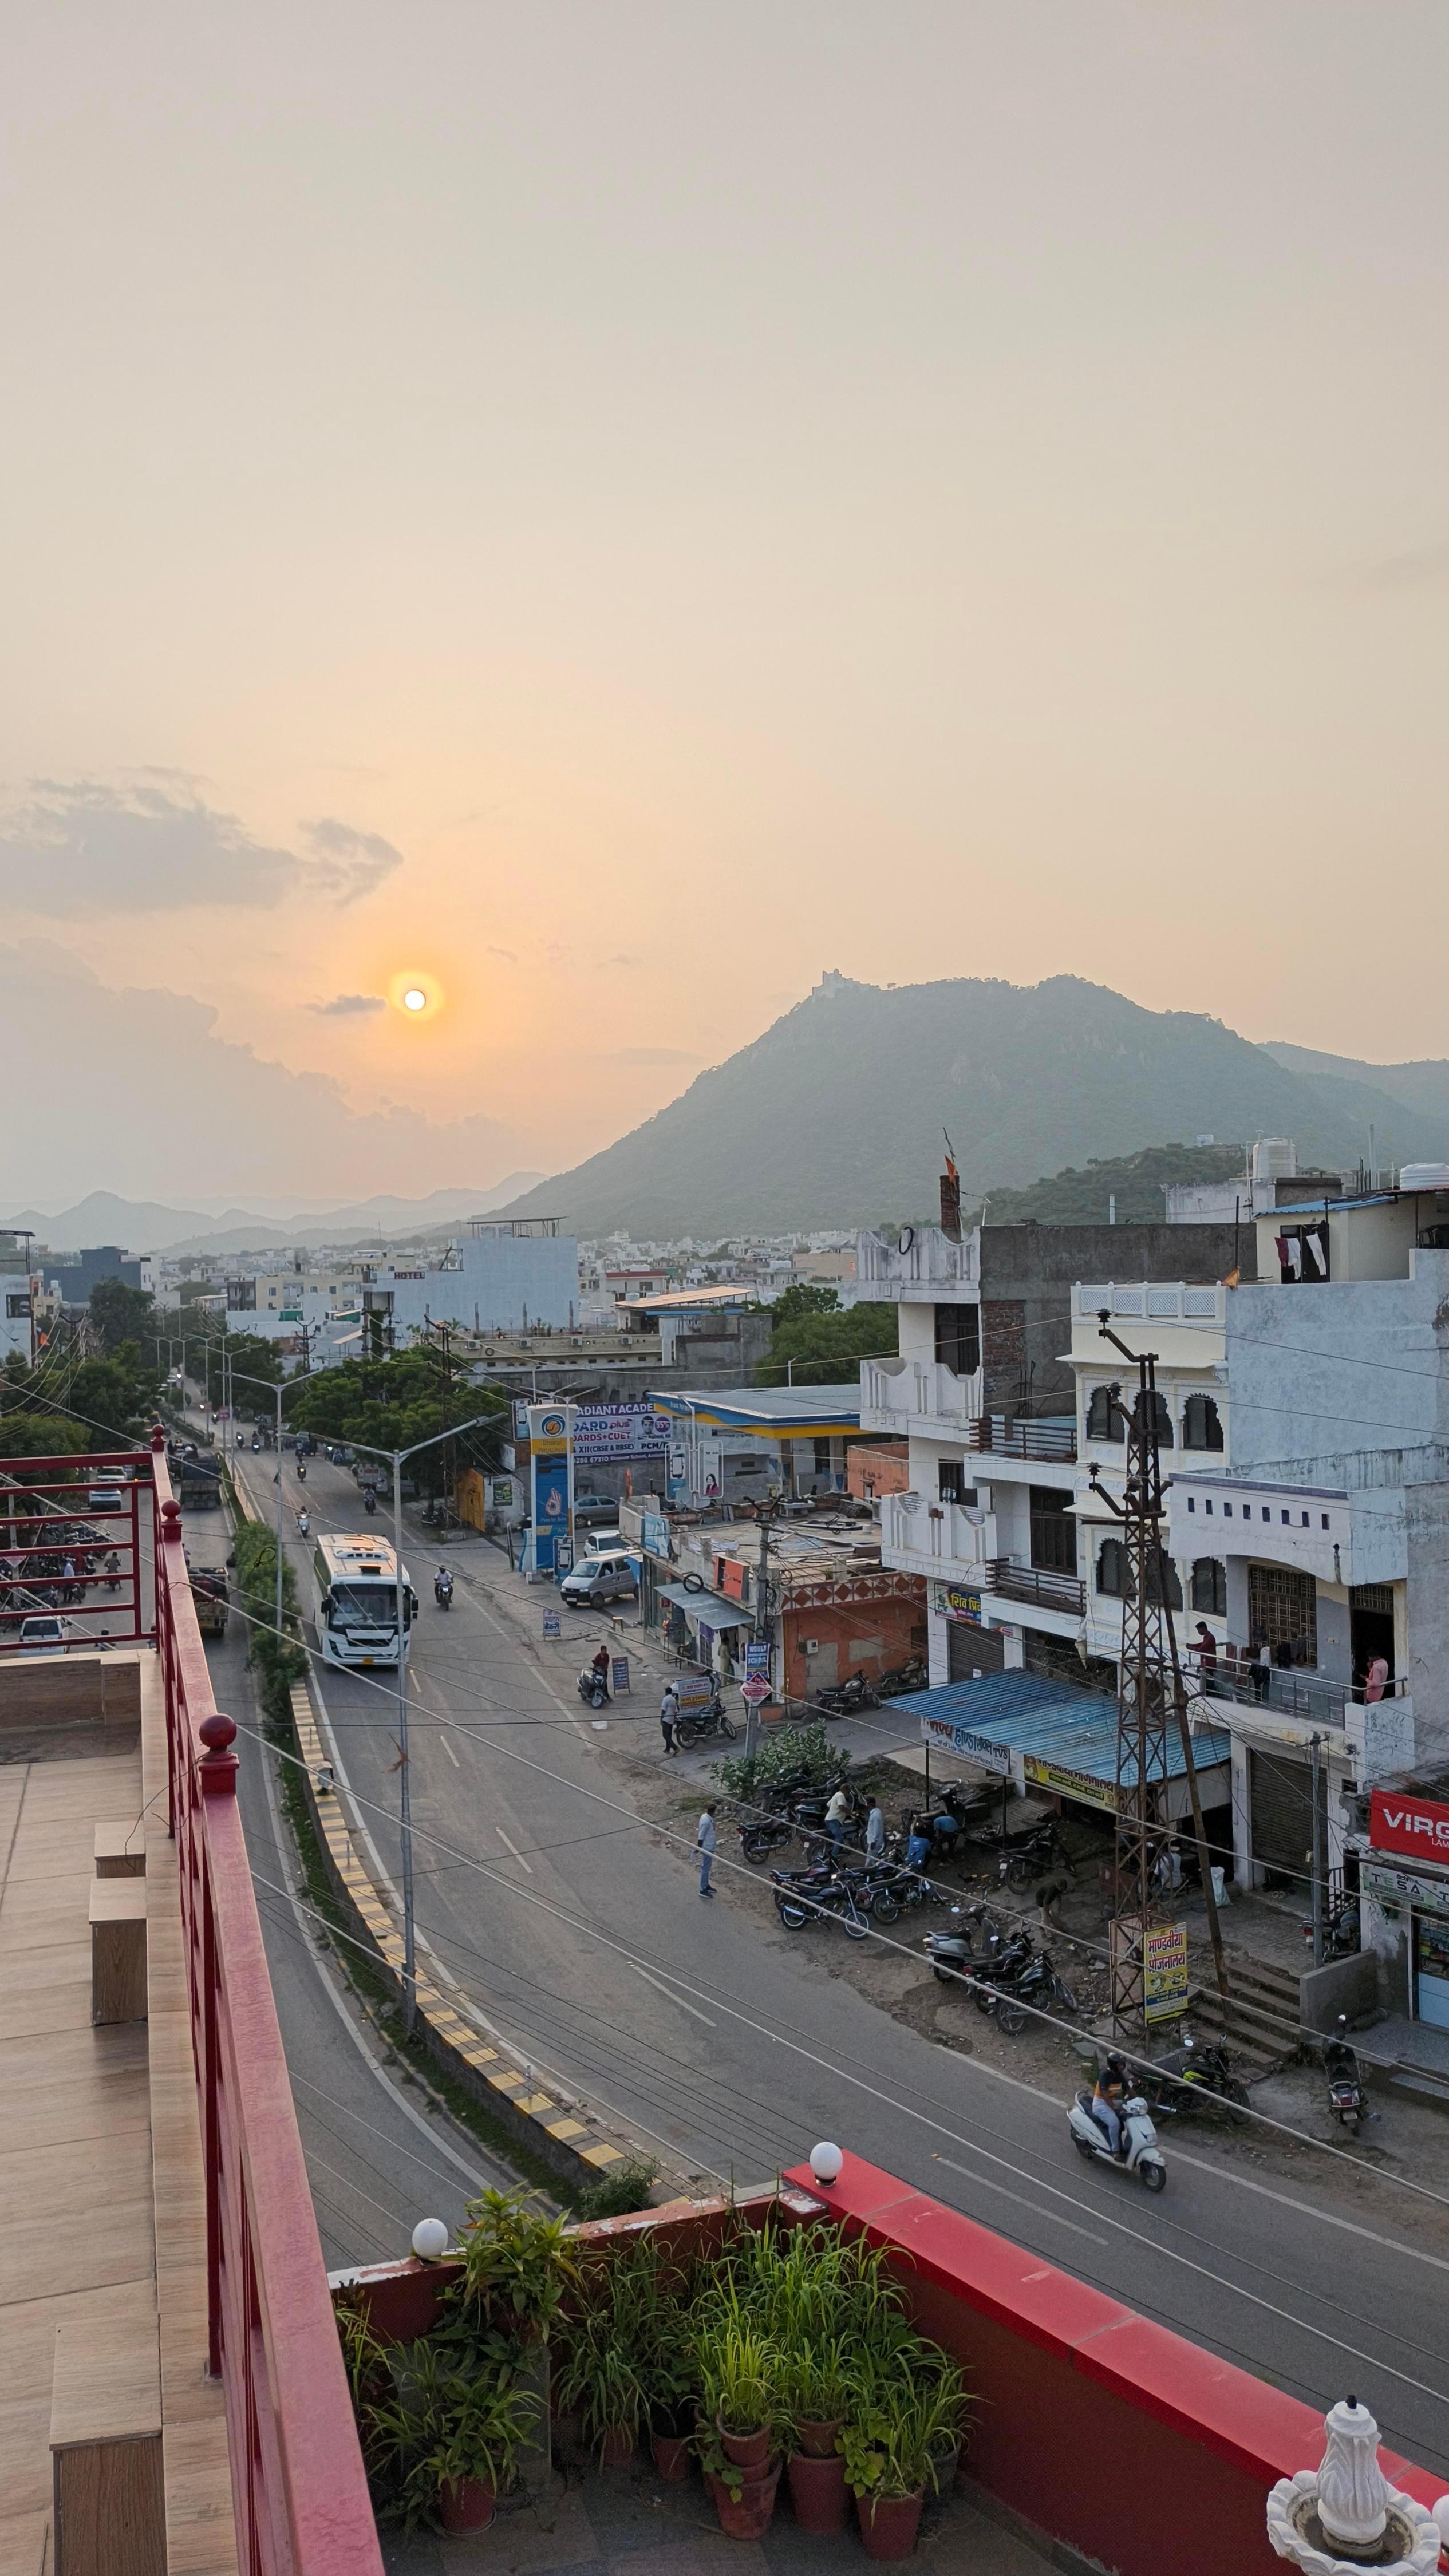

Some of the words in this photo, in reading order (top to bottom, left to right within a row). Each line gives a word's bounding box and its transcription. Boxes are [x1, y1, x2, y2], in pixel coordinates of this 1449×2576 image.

[577, 1406, 616, 1415] ADIANT
[619, 1404, 653, 1413] ACADE
[573, 1421, 607, 1432] OARD
[993, 1747, 1008, 1759] TVS
